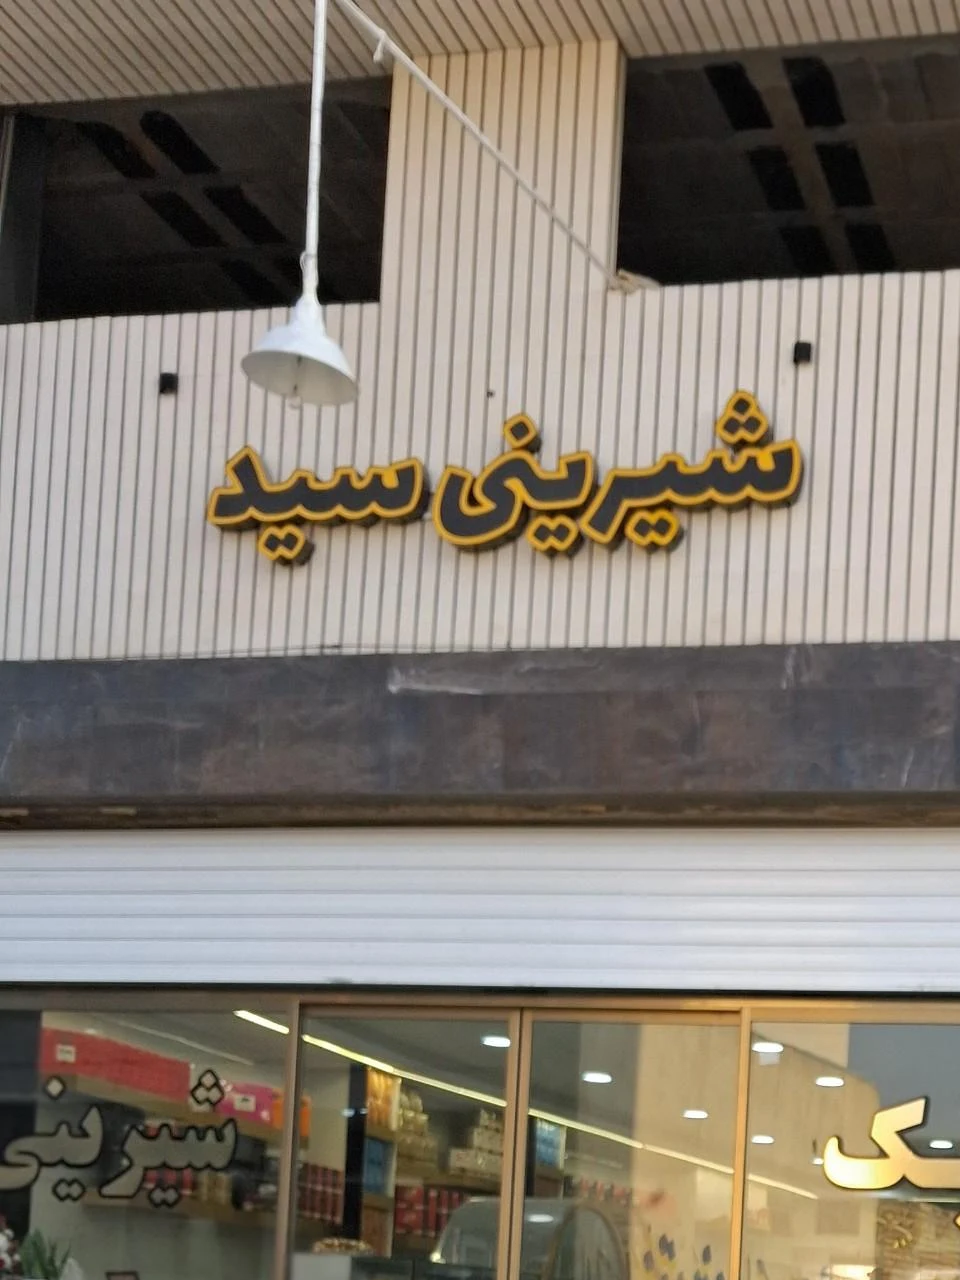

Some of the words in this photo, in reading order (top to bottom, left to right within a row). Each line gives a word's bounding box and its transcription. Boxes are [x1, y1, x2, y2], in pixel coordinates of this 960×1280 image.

[207, 445, 428, 562] سید
[433, 389, 802, 551] شیرینی
[0, 1069, 237, 1207] شیرینی
